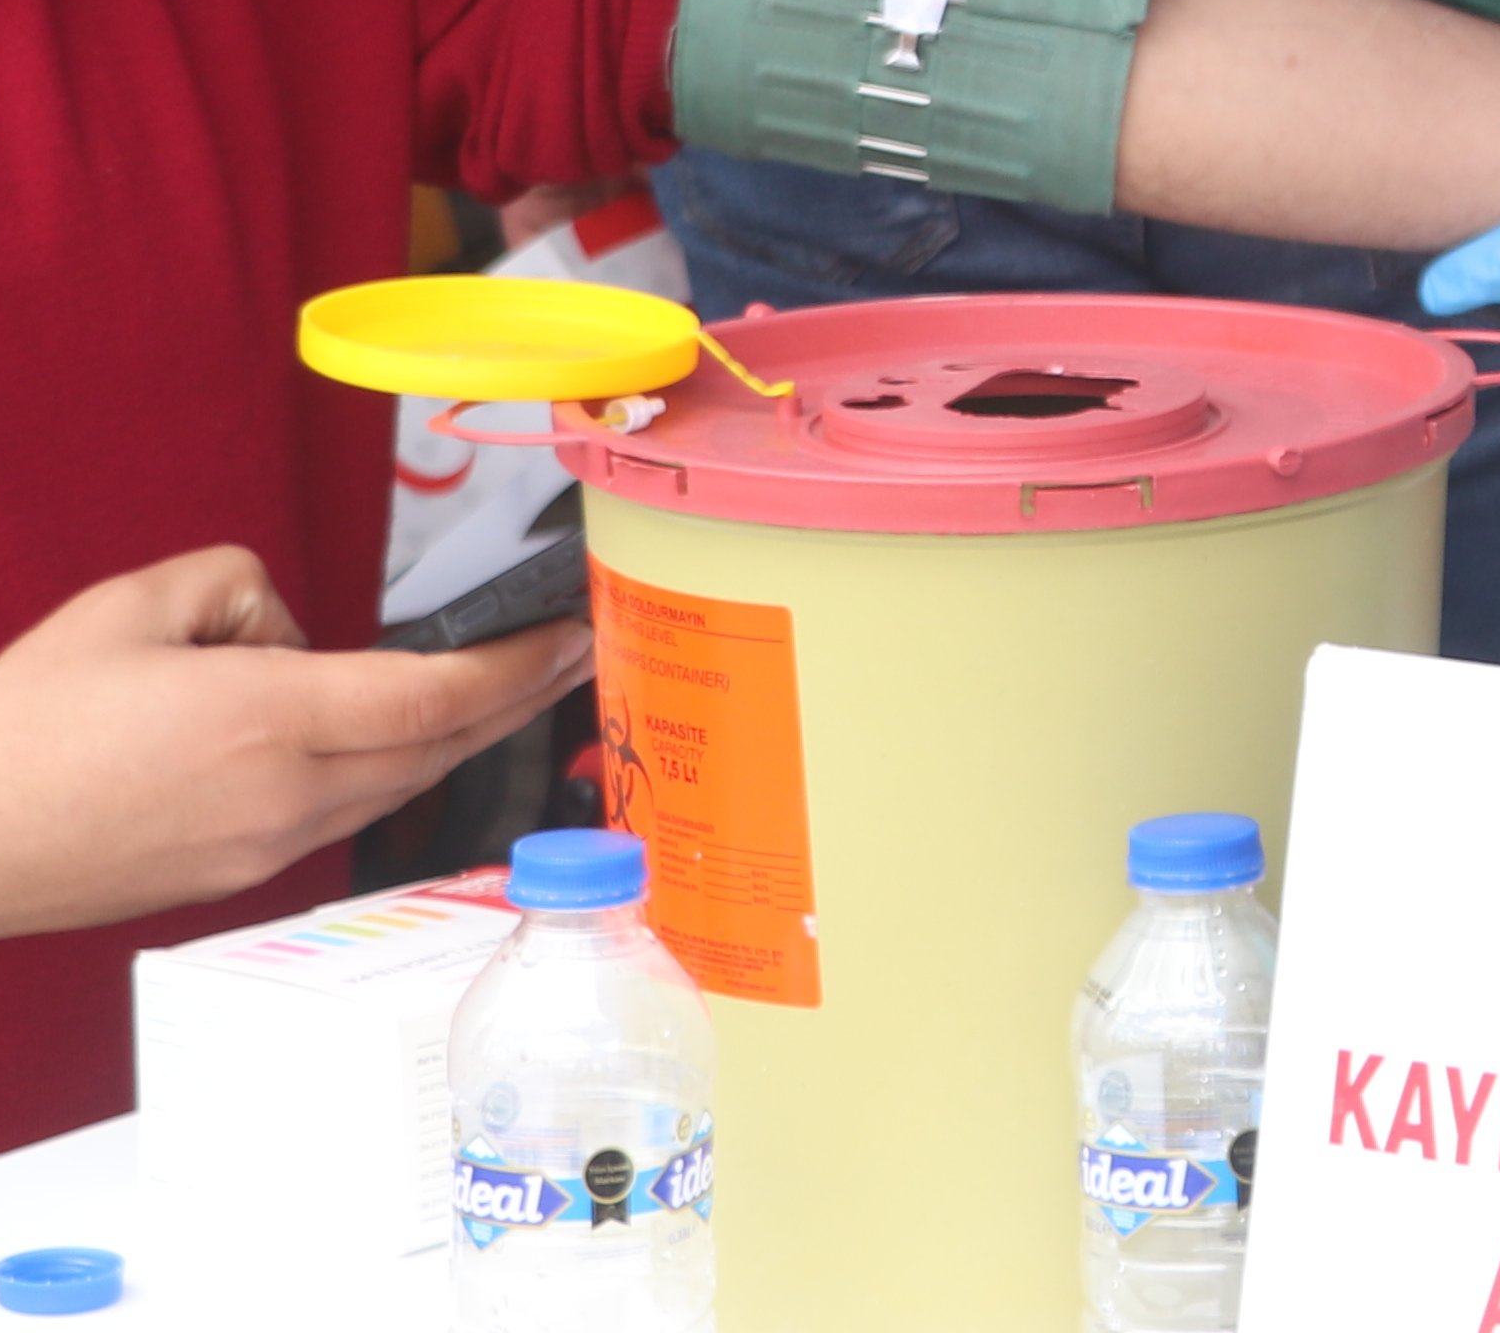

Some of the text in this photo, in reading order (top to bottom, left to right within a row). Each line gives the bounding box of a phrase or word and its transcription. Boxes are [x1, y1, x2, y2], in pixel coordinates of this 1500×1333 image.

[646, 714, 708, 746] KAPASİTE
[668, 1145, 714, 1210] ide
[1081, 1145, 1190, 1208] ideal
